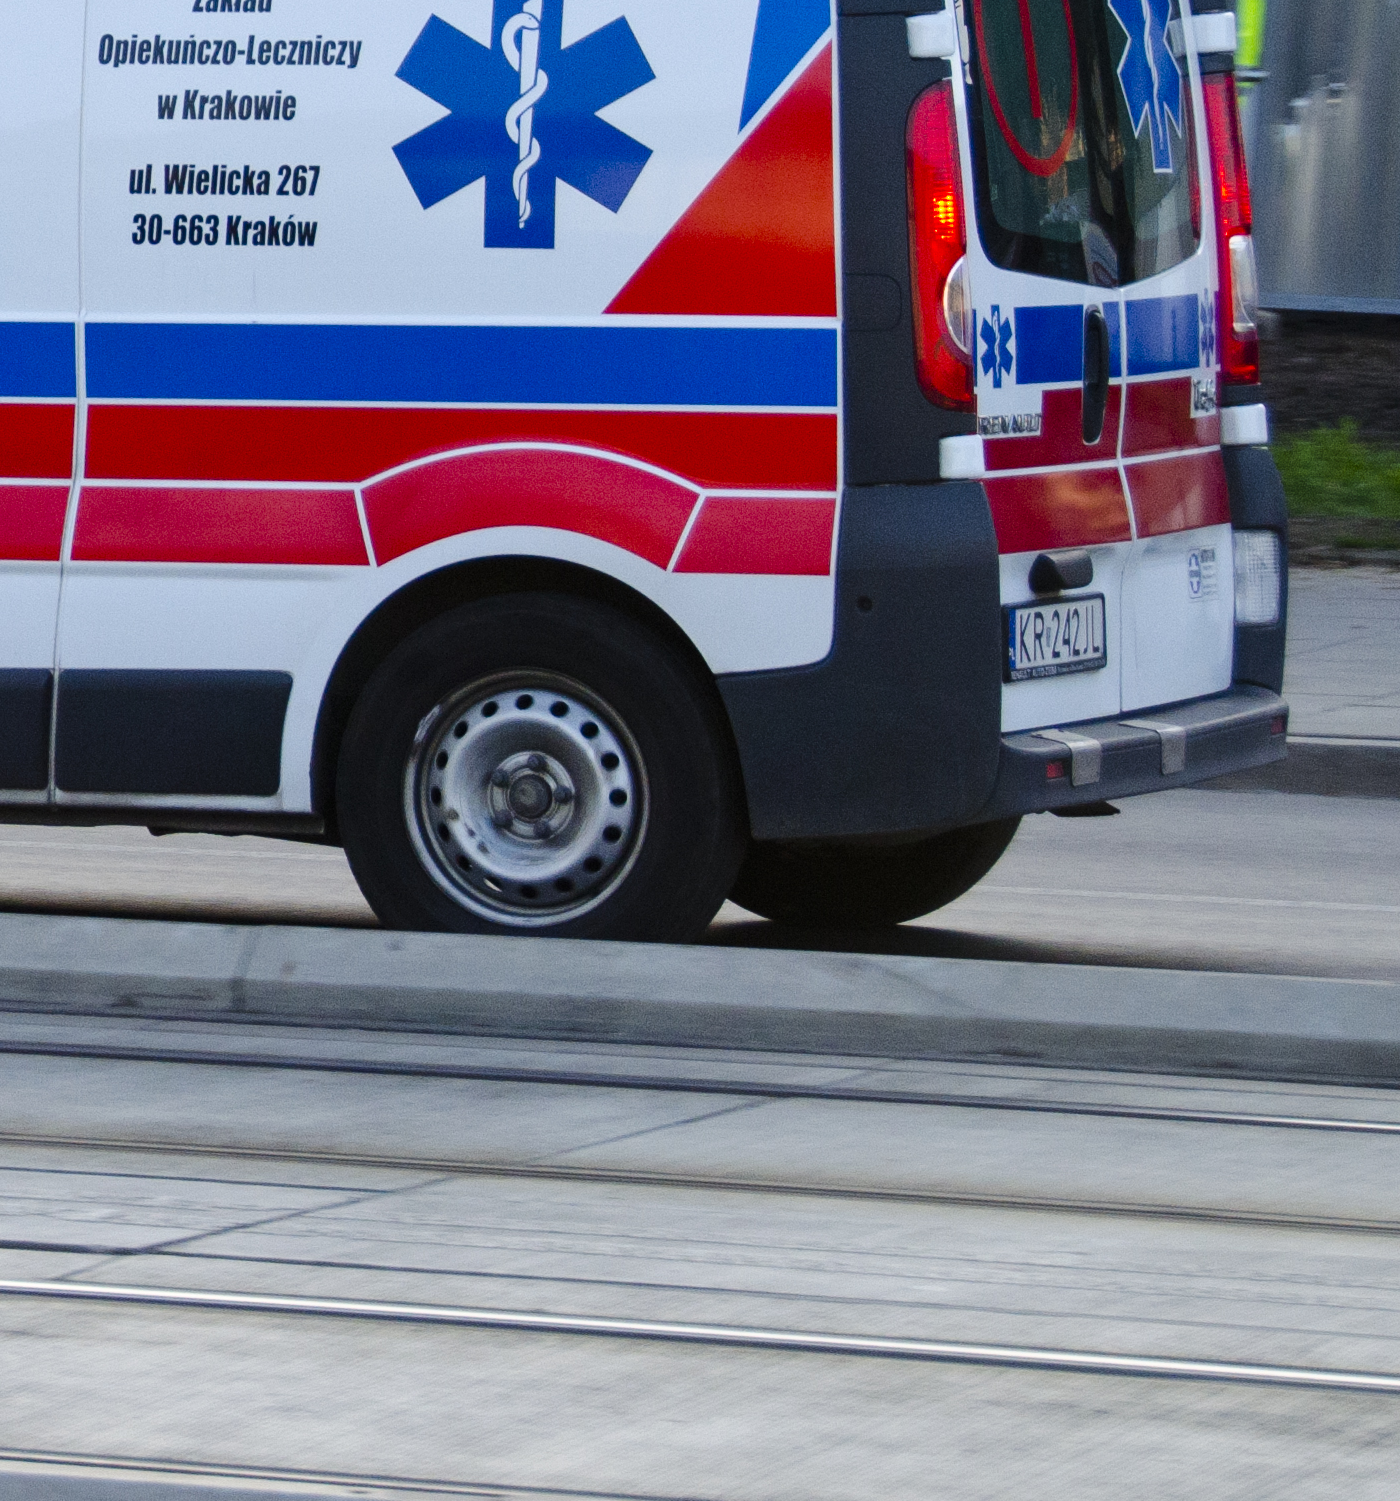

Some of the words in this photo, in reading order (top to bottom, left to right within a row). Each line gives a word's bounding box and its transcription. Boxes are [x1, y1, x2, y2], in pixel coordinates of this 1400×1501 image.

[98, 33, 362, 69] Opiekuńczo-Leczniczy
[157, 94, 177, 120] w
[182, 89, 296, 120] Krakowie
[129, 164, 156, 194] ul.
[164, 164, 271, 196] Wielicka
[276, 164, 320, 196] 267
[131, 213, 220, 245] 30-663
[225, 213, 318, 247] Kraków
[1019, 611, 1045, 663] KR
